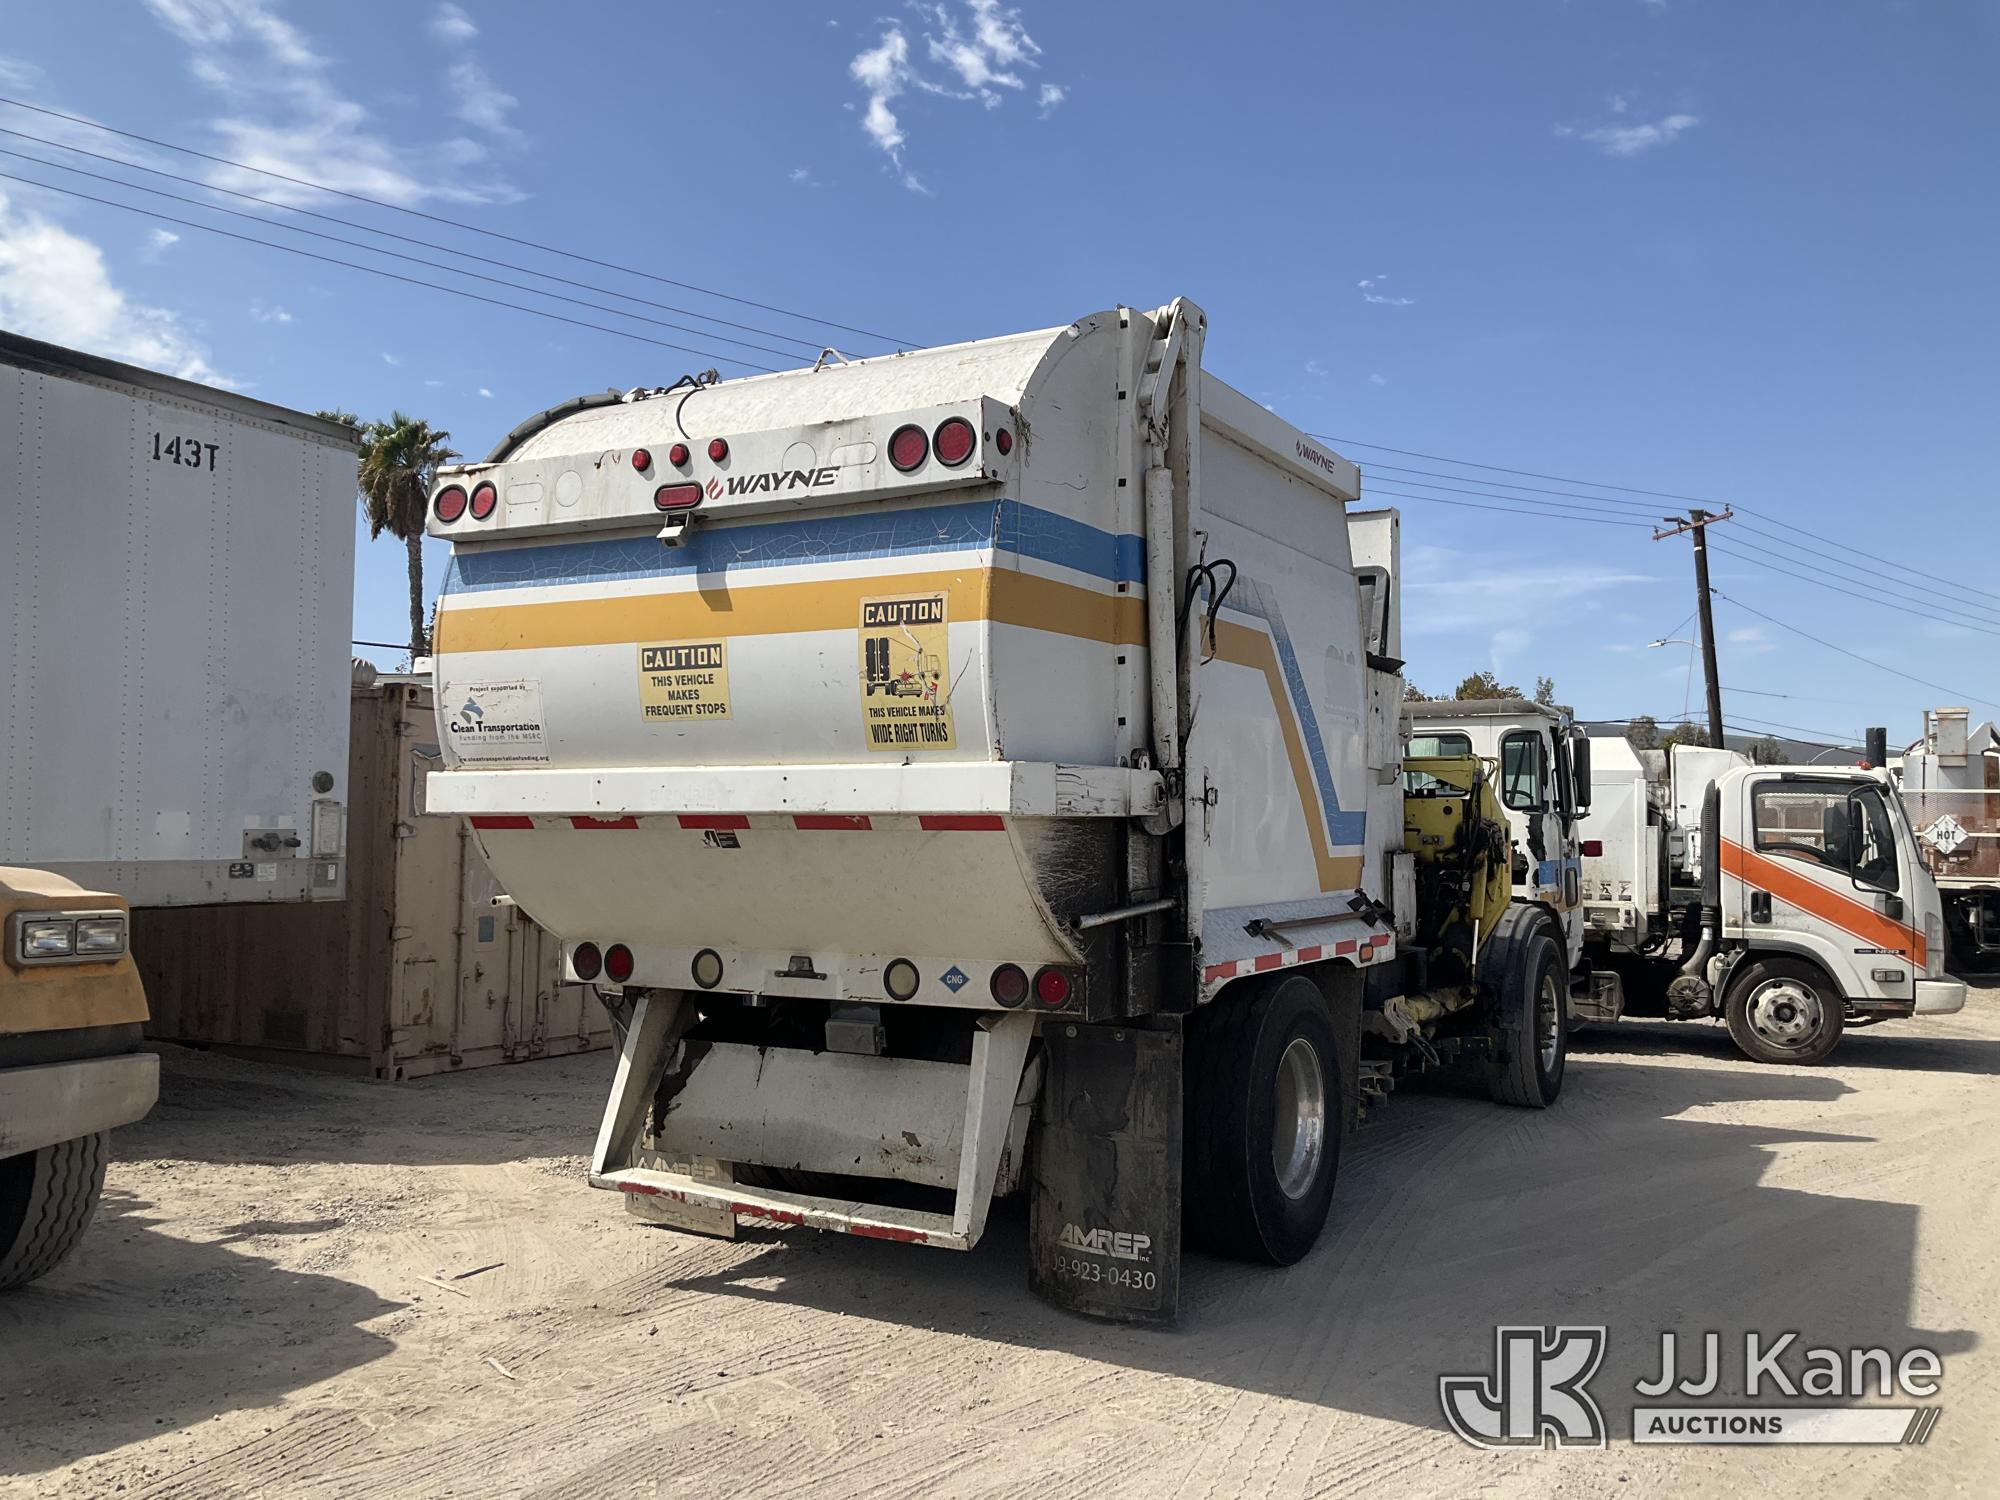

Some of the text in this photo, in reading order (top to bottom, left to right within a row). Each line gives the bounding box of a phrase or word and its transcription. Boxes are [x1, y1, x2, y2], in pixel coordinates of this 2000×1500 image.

[152, 432, 220, 471] 143T
[1302, 444, 1335, 474] WAYNE
[727, 466, 841, 495] WAYNE
[865, 601, 942, 624] CAUTION
[643, 647, 721, 668] CAUTION
[651, 673, 715, 687] THIS VEHICLE
[490, 684, 518, 692] supported
[668, 689, 700, 701] MAKES
[645, 703, 727, 716] FREQUENT STOPS
[868, 705, 945, 718] THIS VEHICLE MAKES
[450, 721, 541, 734] Clean Transportation
[870, 722, 948, 744] WIDE RIGHT TURNS
[1936, 830, 1956, 840] HOT
[946, 974, 963, 984] CNG
[1056, 1222, 1151, 1260] AMREP
